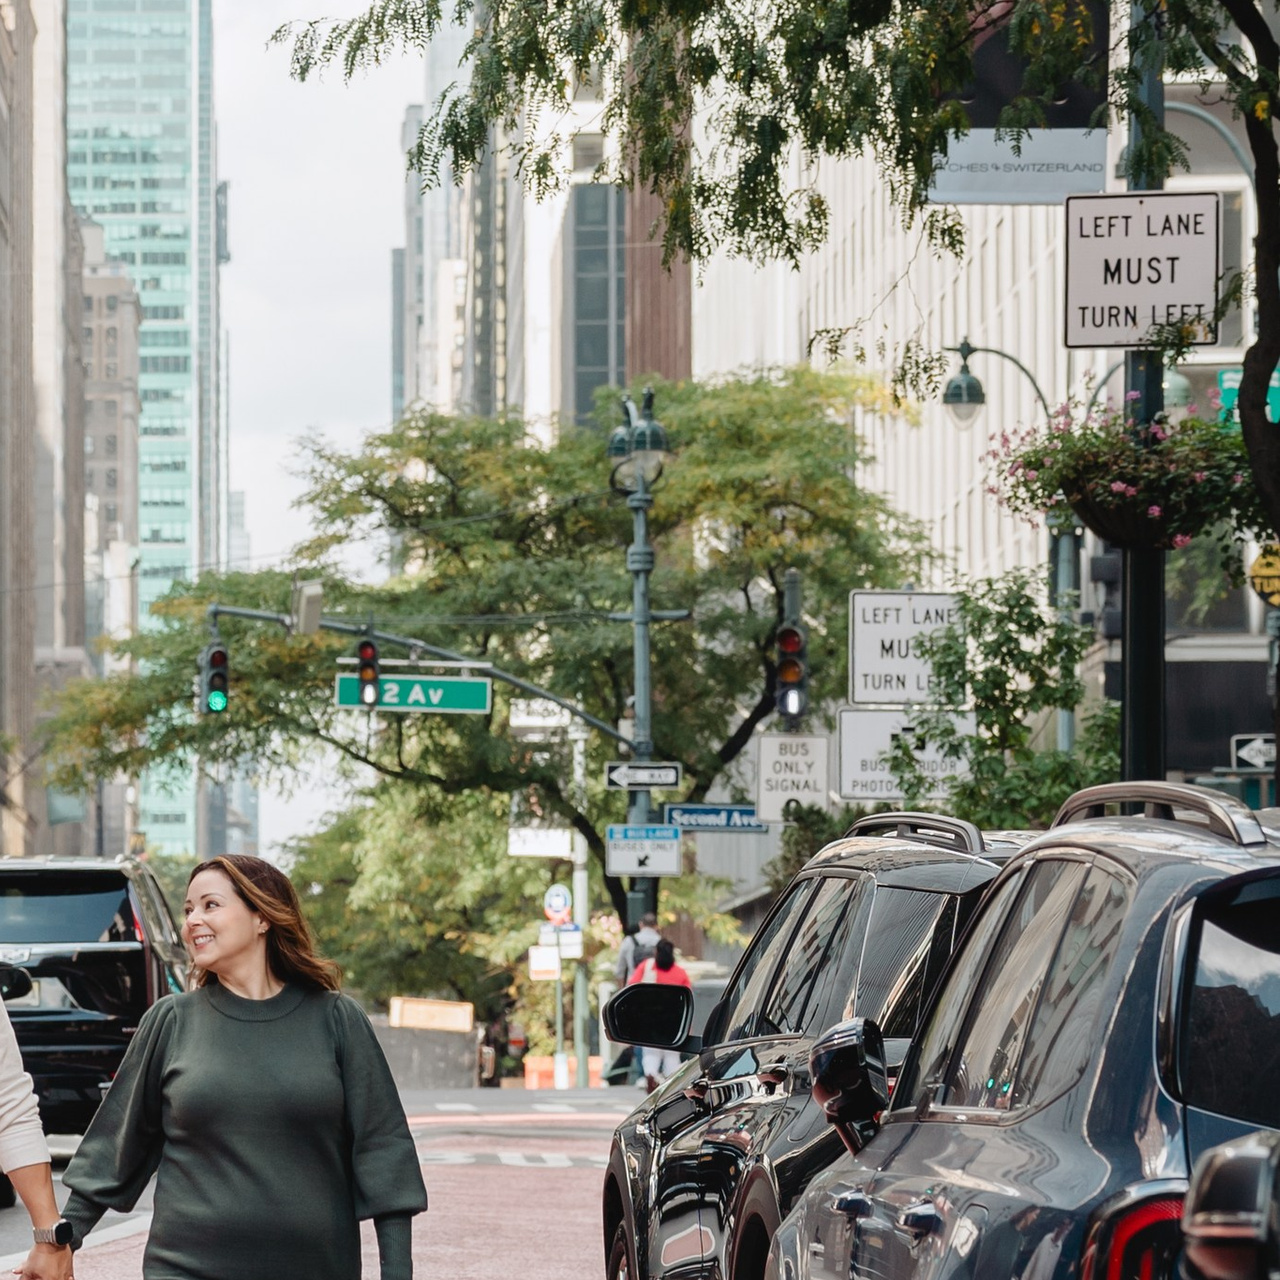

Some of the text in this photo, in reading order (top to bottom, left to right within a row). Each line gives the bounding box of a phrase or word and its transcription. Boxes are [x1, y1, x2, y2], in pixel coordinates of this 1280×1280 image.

[1002, 162, 1104, 174] SWITZERLAND
[1079, 213, 1206, 238] LEFT LANE
[1103, 256, 1180, 286] MUST
[1078, 305, 1138, 328] TURN
[861, 607, 958, 625] LEFT LANE
[861, 673, 907, 691] TURN
[381, 682, 444, 705] 2 Av
[778, 742, 810, 756] BUS
[772, 760, 815, 775] ONLY
[860, 759, 886, 773] BUS
[765, 778, 822, 793] SIGNAL
[851, 780, 894, 793] PHOTO
[671, 809, 728, 826] Second
